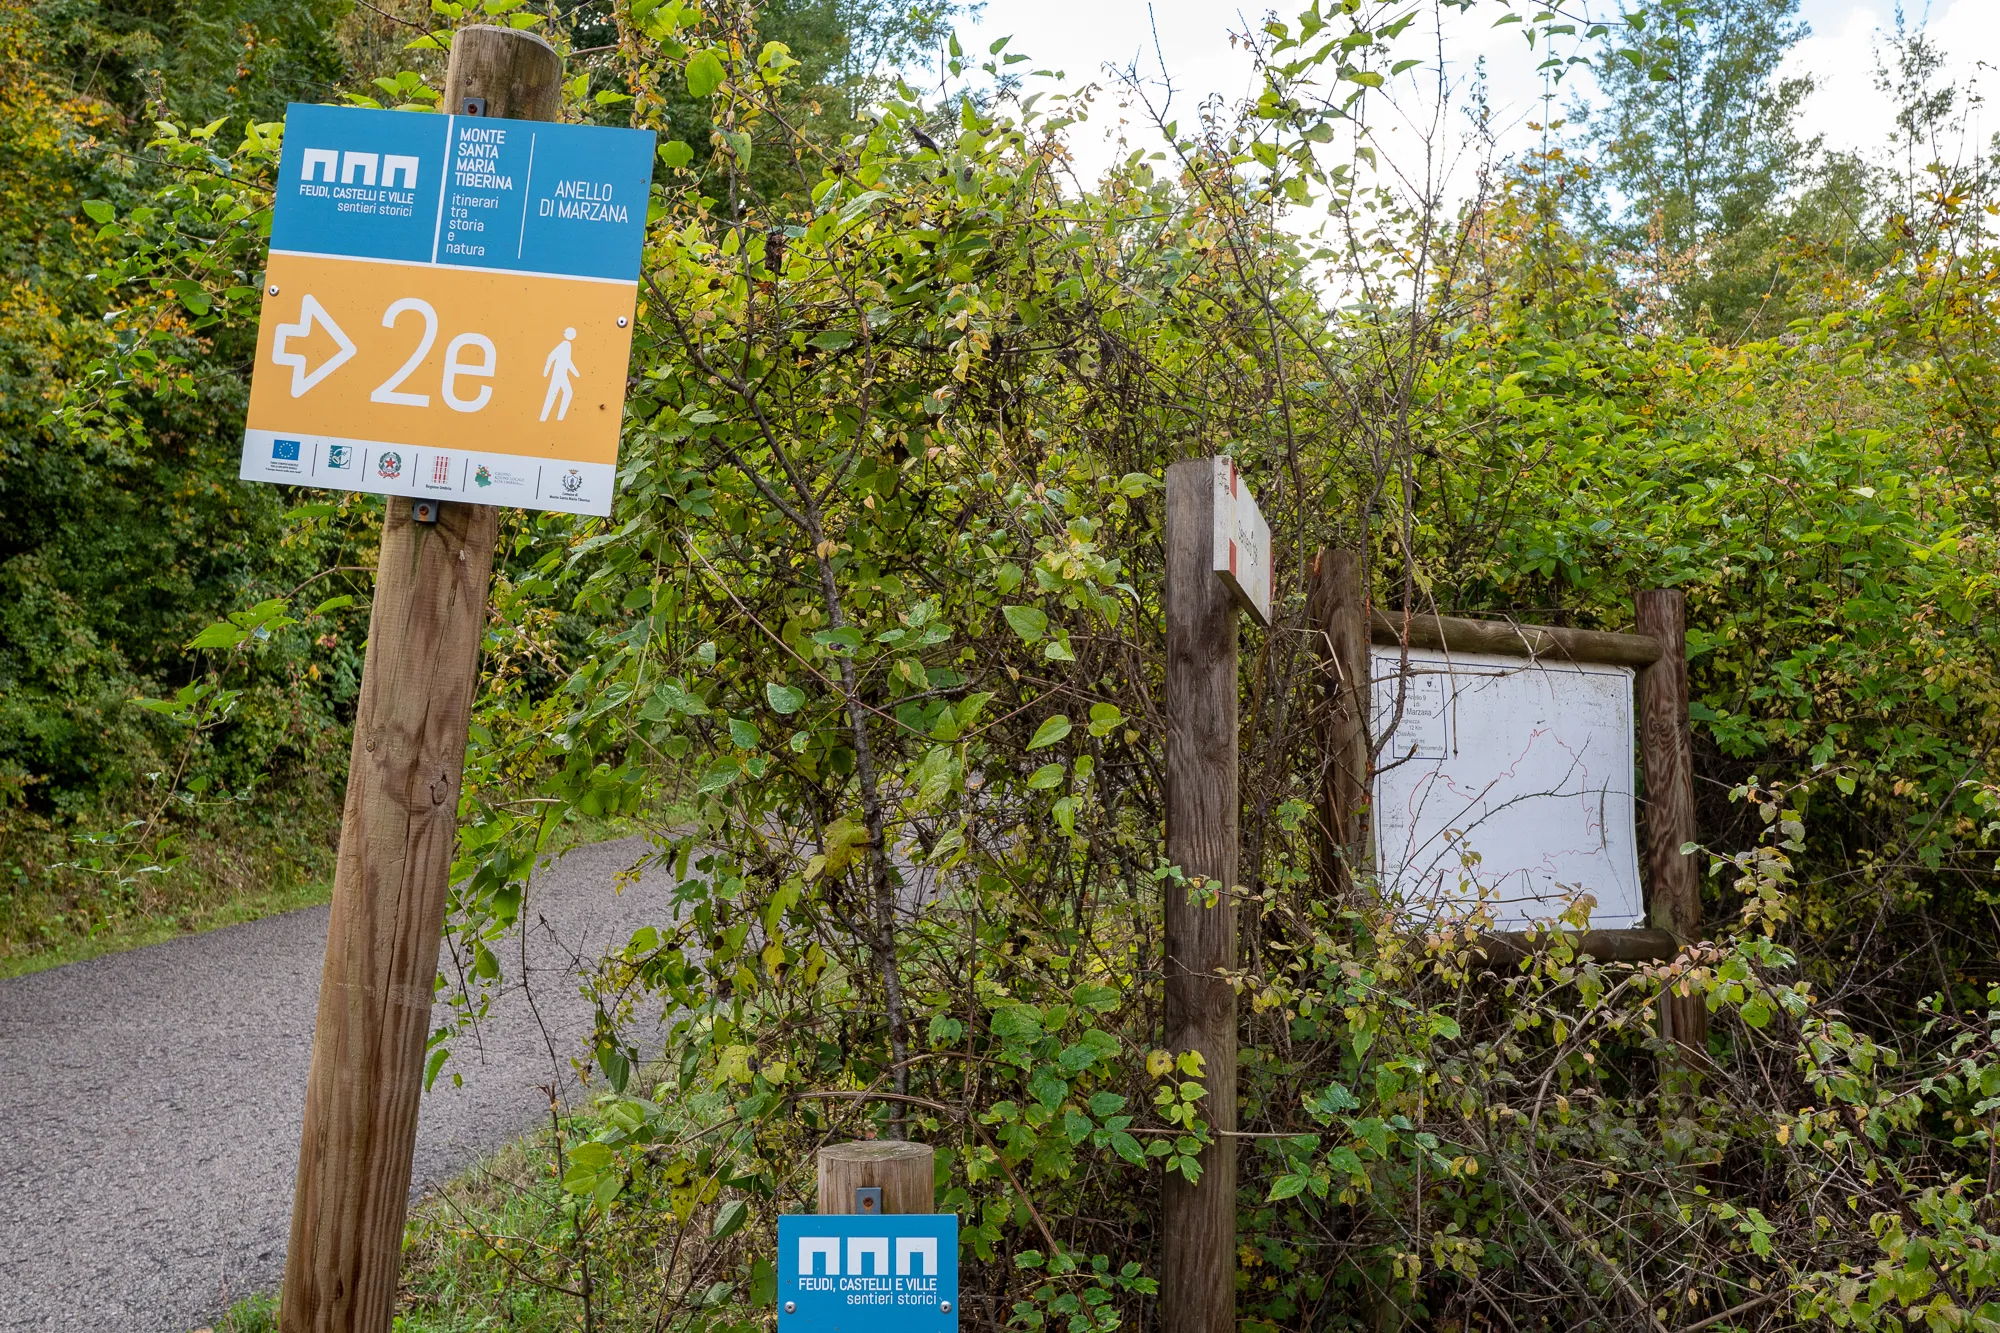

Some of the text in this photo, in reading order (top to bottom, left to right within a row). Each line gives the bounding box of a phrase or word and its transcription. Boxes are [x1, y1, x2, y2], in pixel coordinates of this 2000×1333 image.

[459, 127, 507, 144] MONTE
[457, 142, 499, 159] SANTA
[456, 157, 496, 174] MARIA
[455, 171, 513, 191] TIBERINA
[299, 184, 415, 204] FEUDI, CASTELLI E VILLE
[554, 179, 613, 202] ANELLO
[337, 201, 413, 217] sentieri storici
[452, 192, 499, 209] itinerari
[450, 206, 468, 219] tra
[539, 198, 628, 224] DI MARZANA
[449, 218, 485, 232] storia
[447, 231, 455, 242] e
[446, 243, 485, 256] natura
[370, 297, 497, 413] 2e
[799, 1277, 938, 1293] FEUDI, CASTELLI E VILLE
[846, 1291, 937, 1305] sentieri storici
